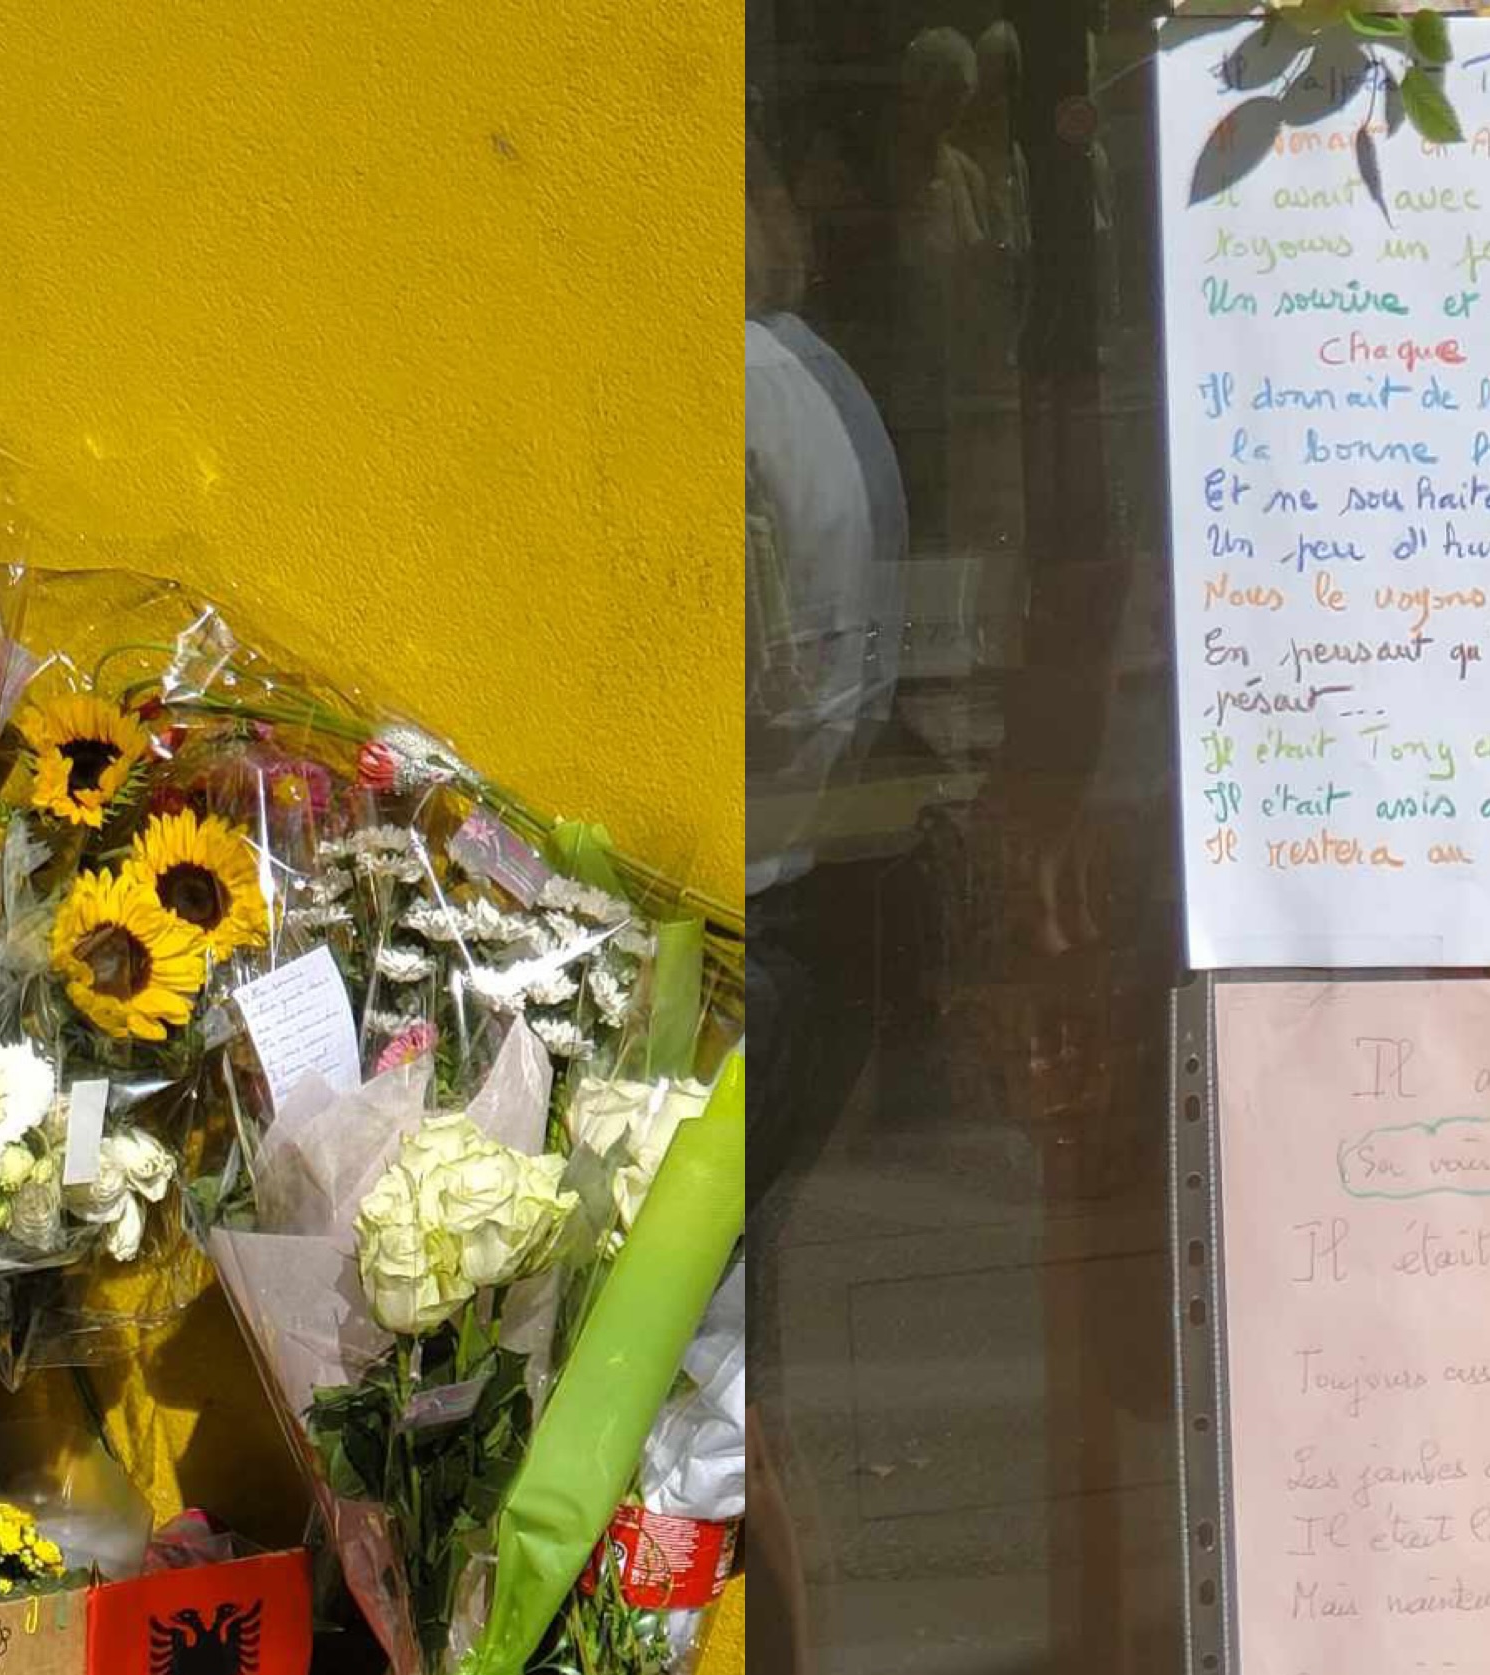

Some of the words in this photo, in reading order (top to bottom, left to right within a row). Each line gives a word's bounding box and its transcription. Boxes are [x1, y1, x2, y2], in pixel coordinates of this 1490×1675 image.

[1395, 186, 1481, 212] avec
[1275, 281, 1409, 318] sourire
[1445, 290, 1480, 318] et
[1199, 373, 1235, 419] Il
[1253, 375, 1410, 412] donnait
[1423, 376, 1459, 413] de
[1229, 430, 1271, 464] la
[1305, 430, 1439, 465] bonne
[1203, 470, 1251, 513] Et
[1264, 487, 1319, 512] ne
[1280, 539, 1366, 574] peu
[1203, 576, 1285, 611] Nous
[1314, 571, 1347, 612] le
[1203, 625, 1251, 668] En
[1359, 723, 1457, 782] Tony
[1204, 782, 1242, 823] Il
[1375, 792, 1458, 821] assis
[1266, 828, 1404, 866] restera
[1427, 842, 1473, 865] au
